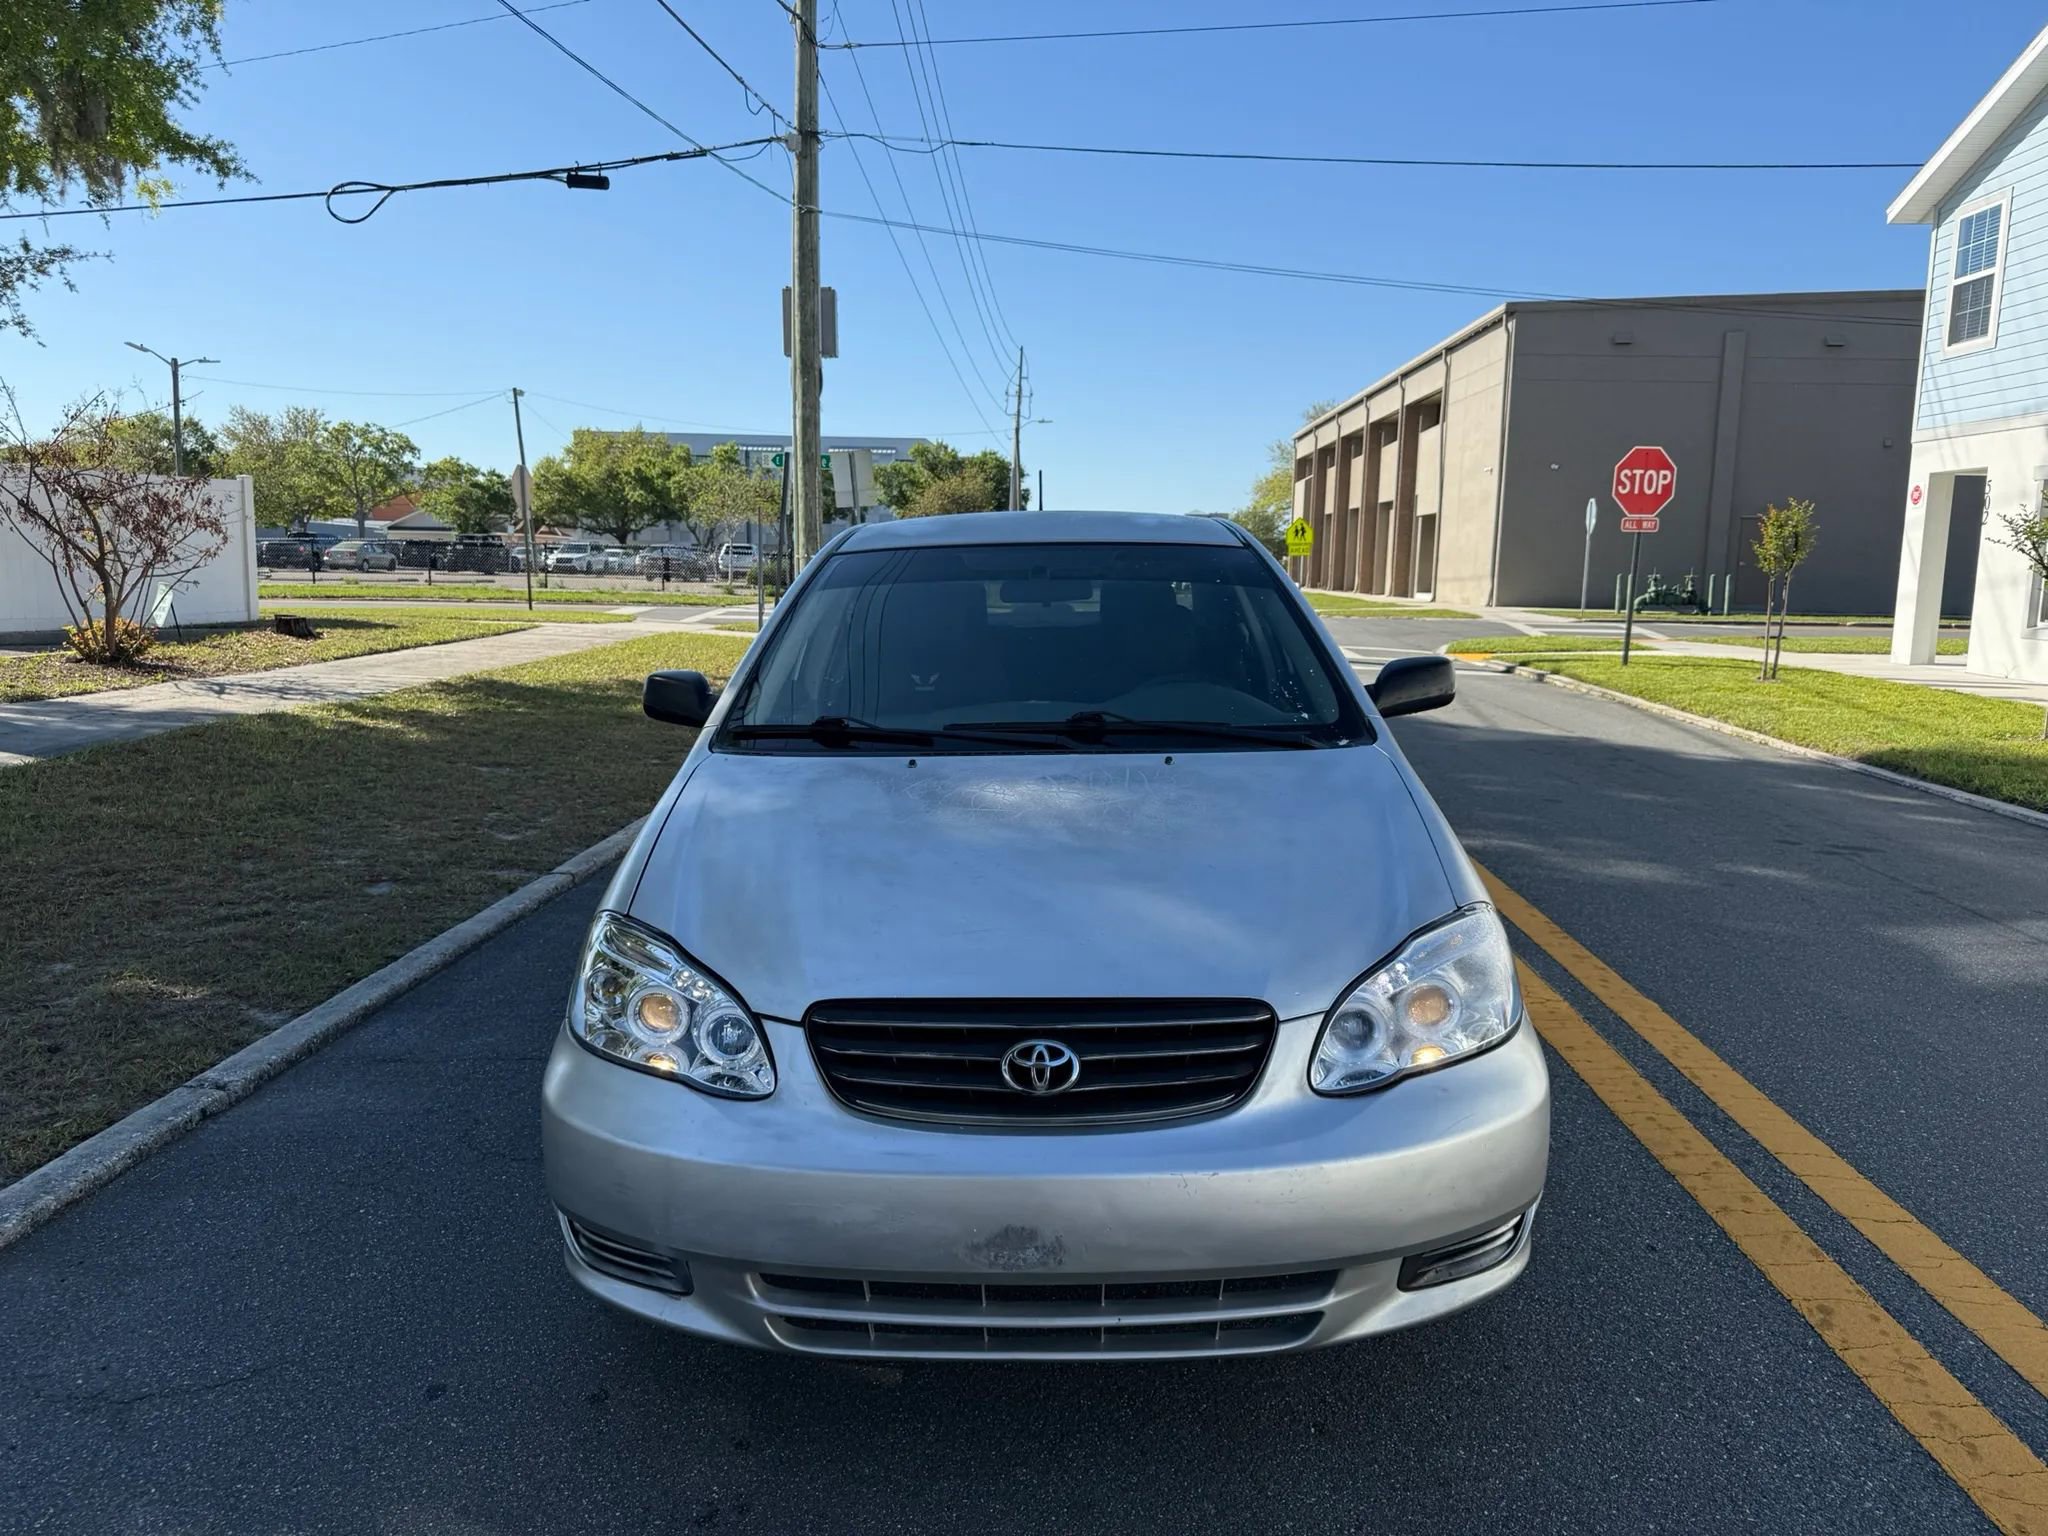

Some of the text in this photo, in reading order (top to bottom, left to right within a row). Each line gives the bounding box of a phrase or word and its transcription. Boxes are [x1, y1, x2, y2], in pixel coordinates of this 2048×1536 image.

[1617, 468, 1672, 495] STOP
[1982, 479, 1992, 525] 502
[1624, 520, 1657, 529] ALL WAY
